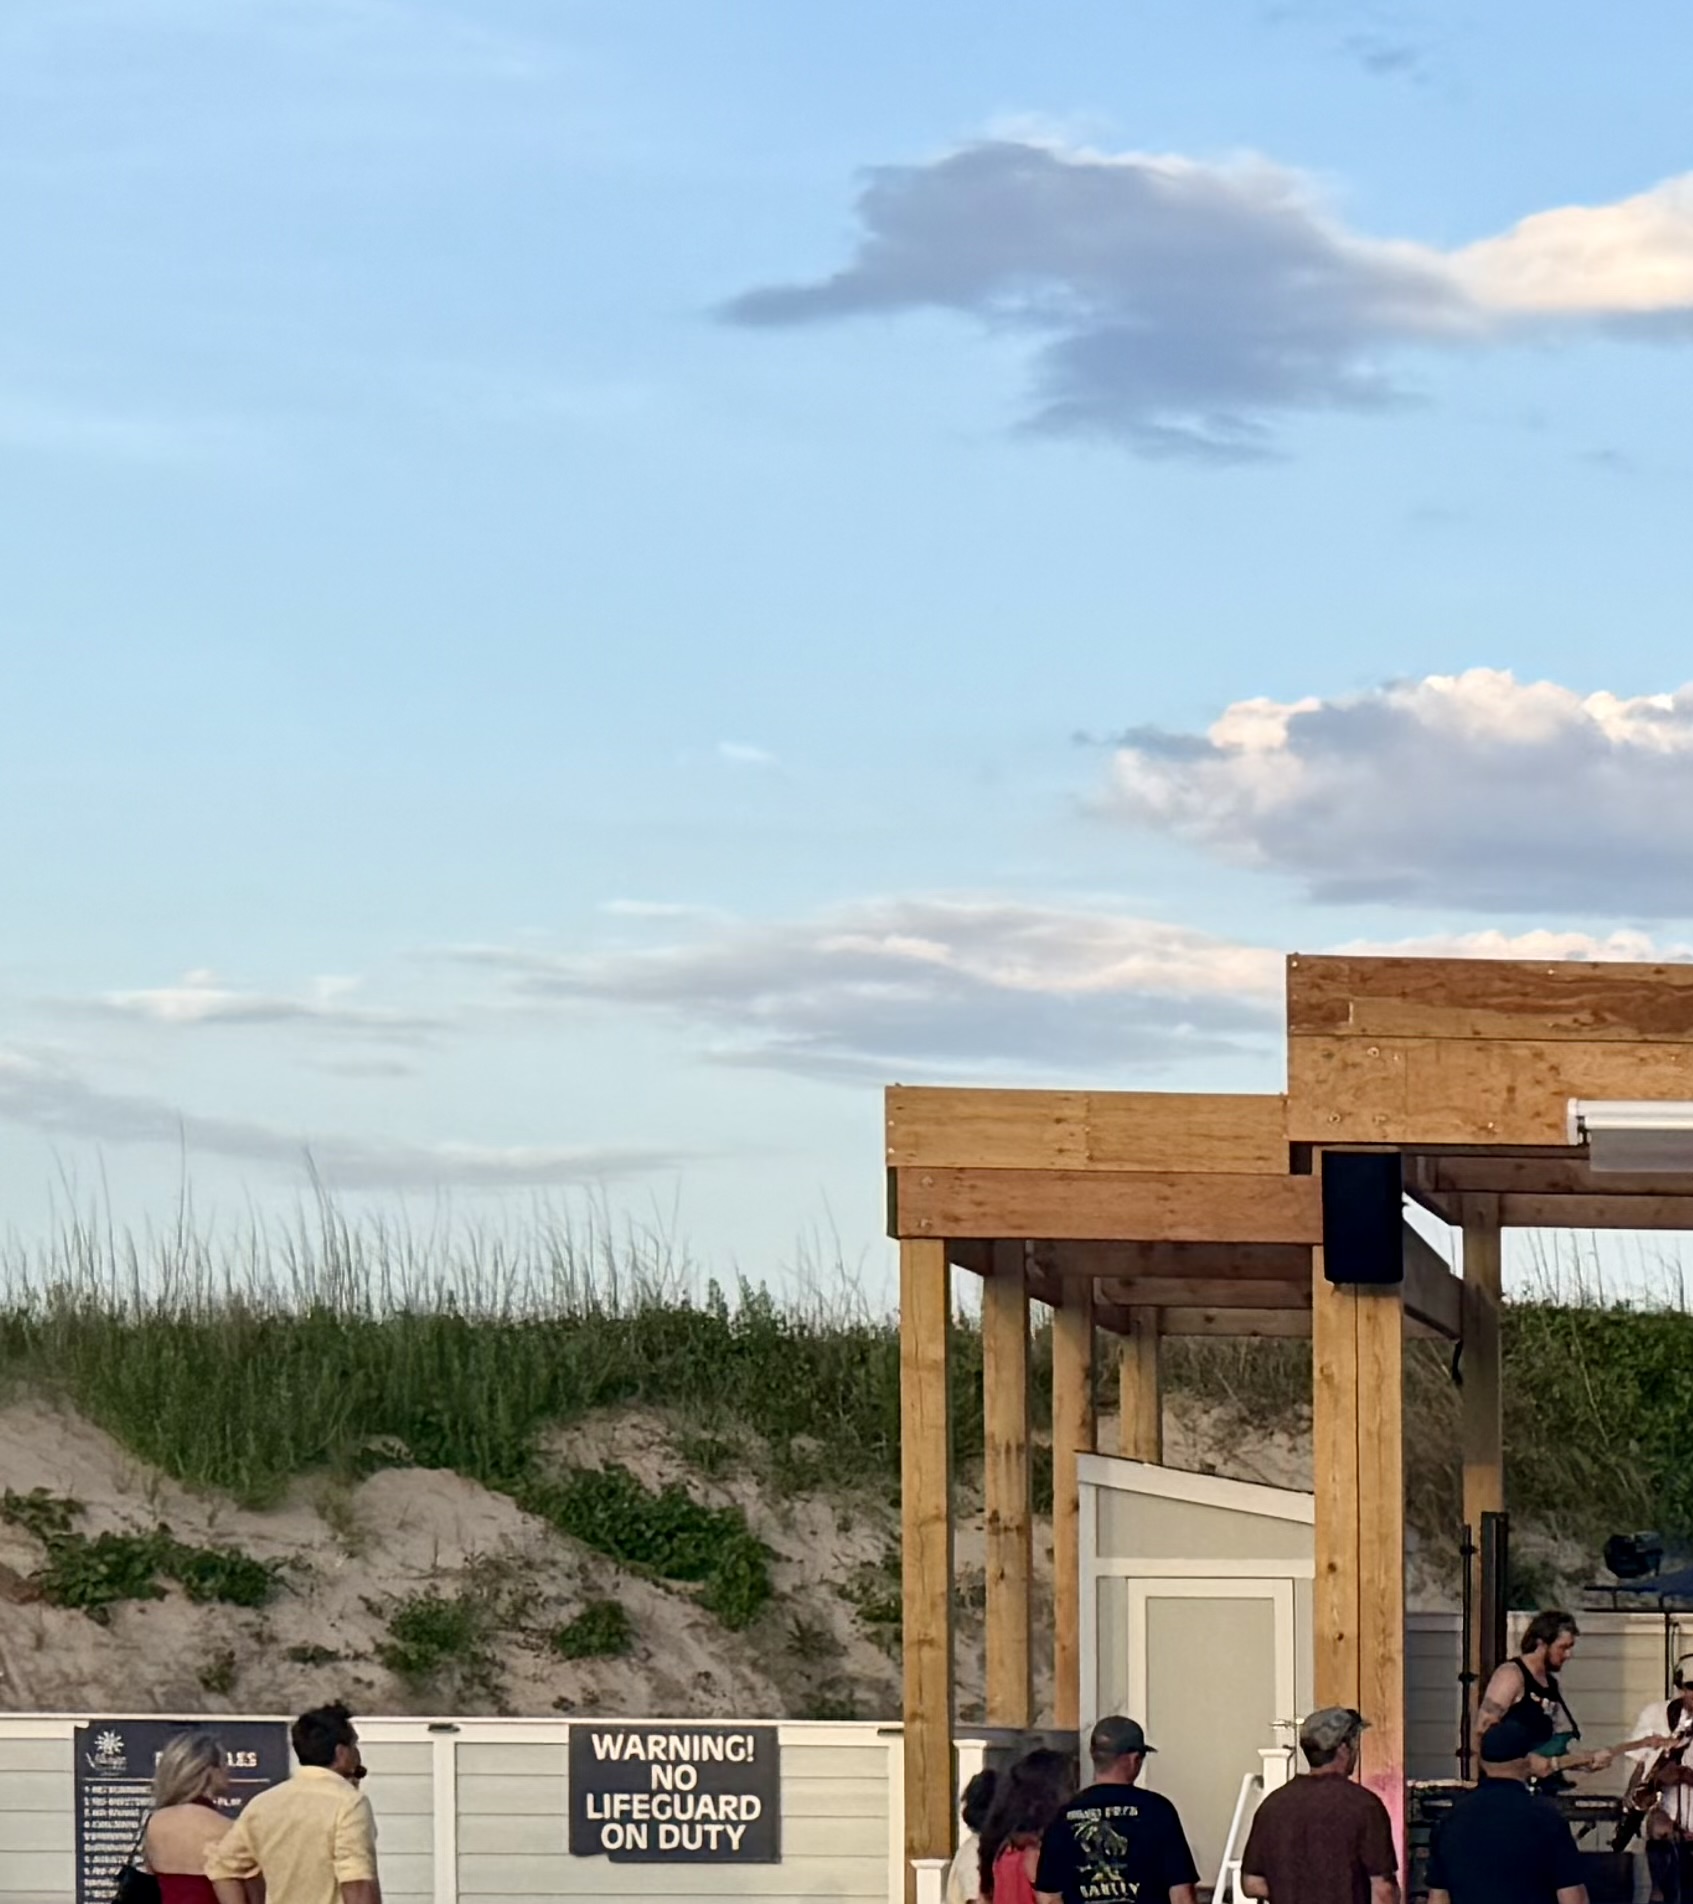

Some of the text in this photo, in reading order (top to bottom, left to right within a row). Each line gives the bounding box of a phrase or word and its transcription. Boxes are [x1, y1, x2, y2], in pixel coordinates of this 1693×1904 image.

[227, 1751, 257, 1767] LES
[591, 1733, 754, 1762] WARNING!
[651, 1764, 697, 1791] NO
[586, 1793, 762, 1820] LIFEGUARD
[601, 1823, 746, 1850] ON DUTY
